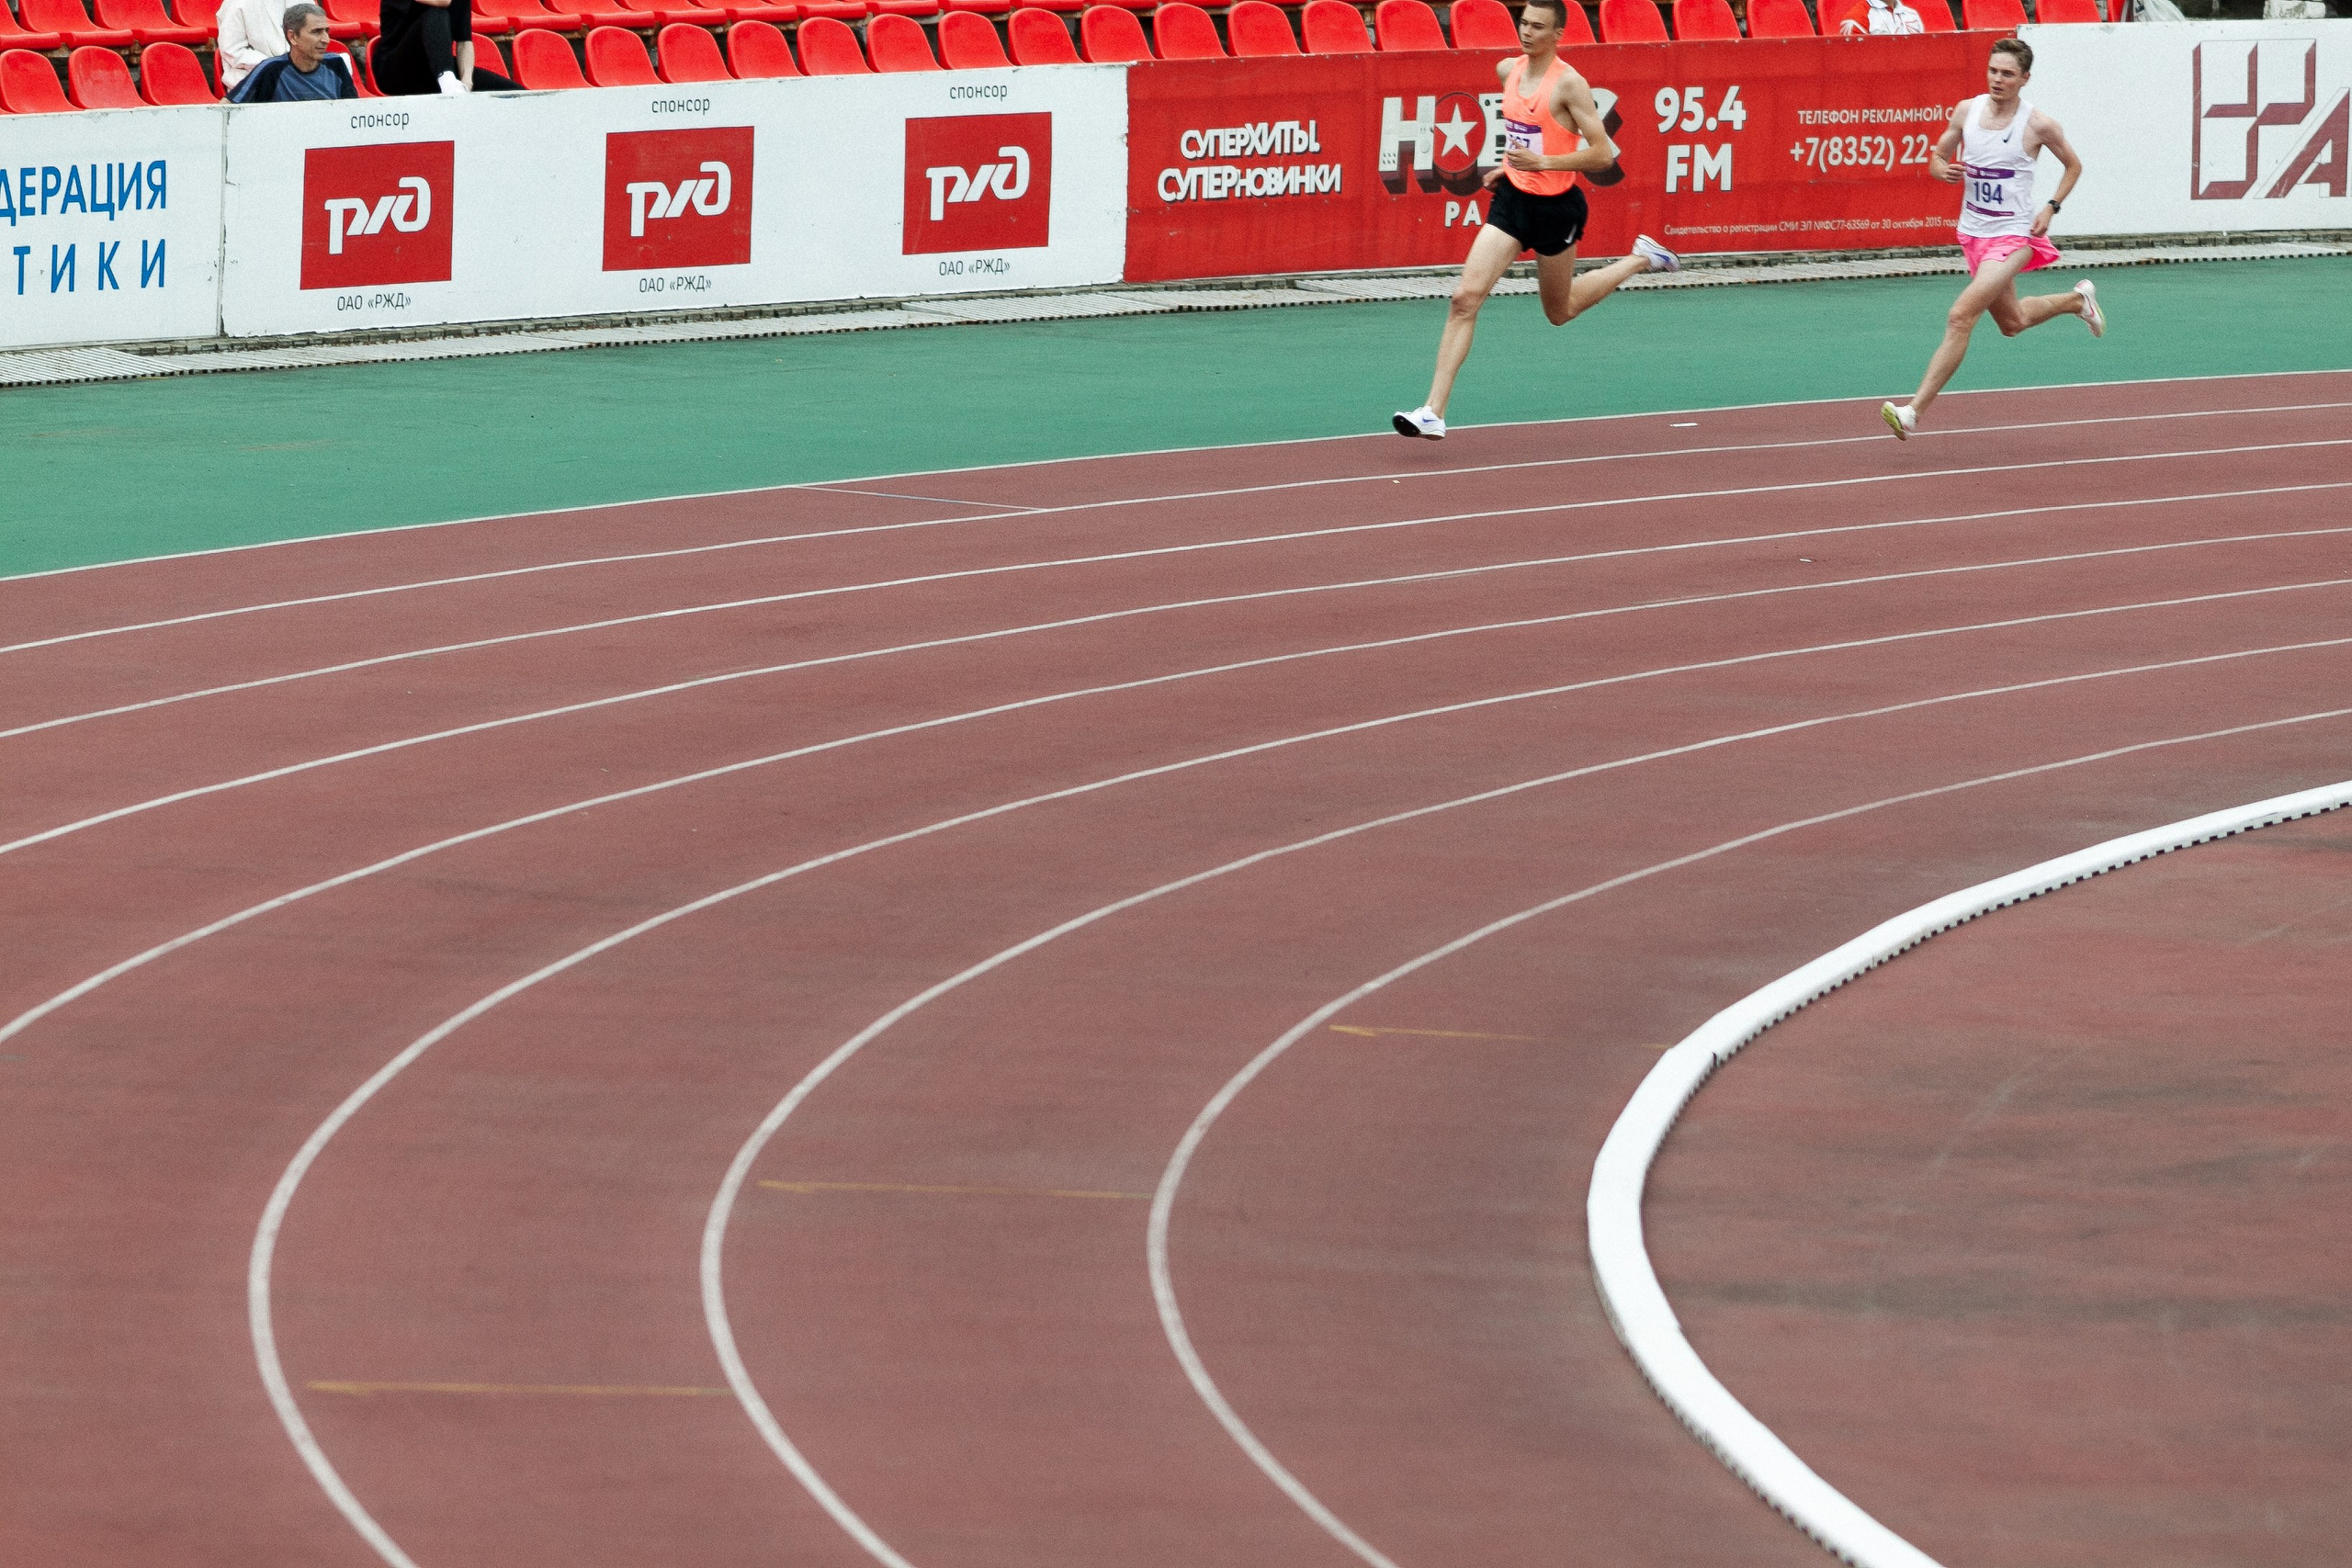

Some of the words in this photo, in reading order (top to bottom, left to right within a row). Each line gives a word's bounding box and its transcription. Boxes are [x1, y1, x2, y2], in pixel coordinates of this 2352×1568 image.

[950, 85, 1008, 102] спонсор
[651, 96, 710, 116] спонсор
[1655, 85, 1746, 133] 95.4
[1798, 110, 1859, 125] ТЕЛЕФОН
[1861, 105, 1942, 123] РЕКЛАМНОЙ
[351, 112, 409, 130] спонсор
[1790, 135, 1894, 173] +7(8352)
[1666, 143, 1732, 193] FM
[1158, 164, 1341, 202] СУПЕРНОВИНКИ
[1973, 182, 2003, 204] 194
[1882, 219, 1892, 229] 30
[1925, 216, 1941, 228] 2015
[939, 261, 965, 276] ОАО
[968, 259, 1011, 276] «РЖД»
[639, 278, 664, 293] ОАО
[670, 276, 712, 292] «РЖД»
[336, 295, 363, 311] ОАО
[368, 292, 412, 310] «РЖД»
